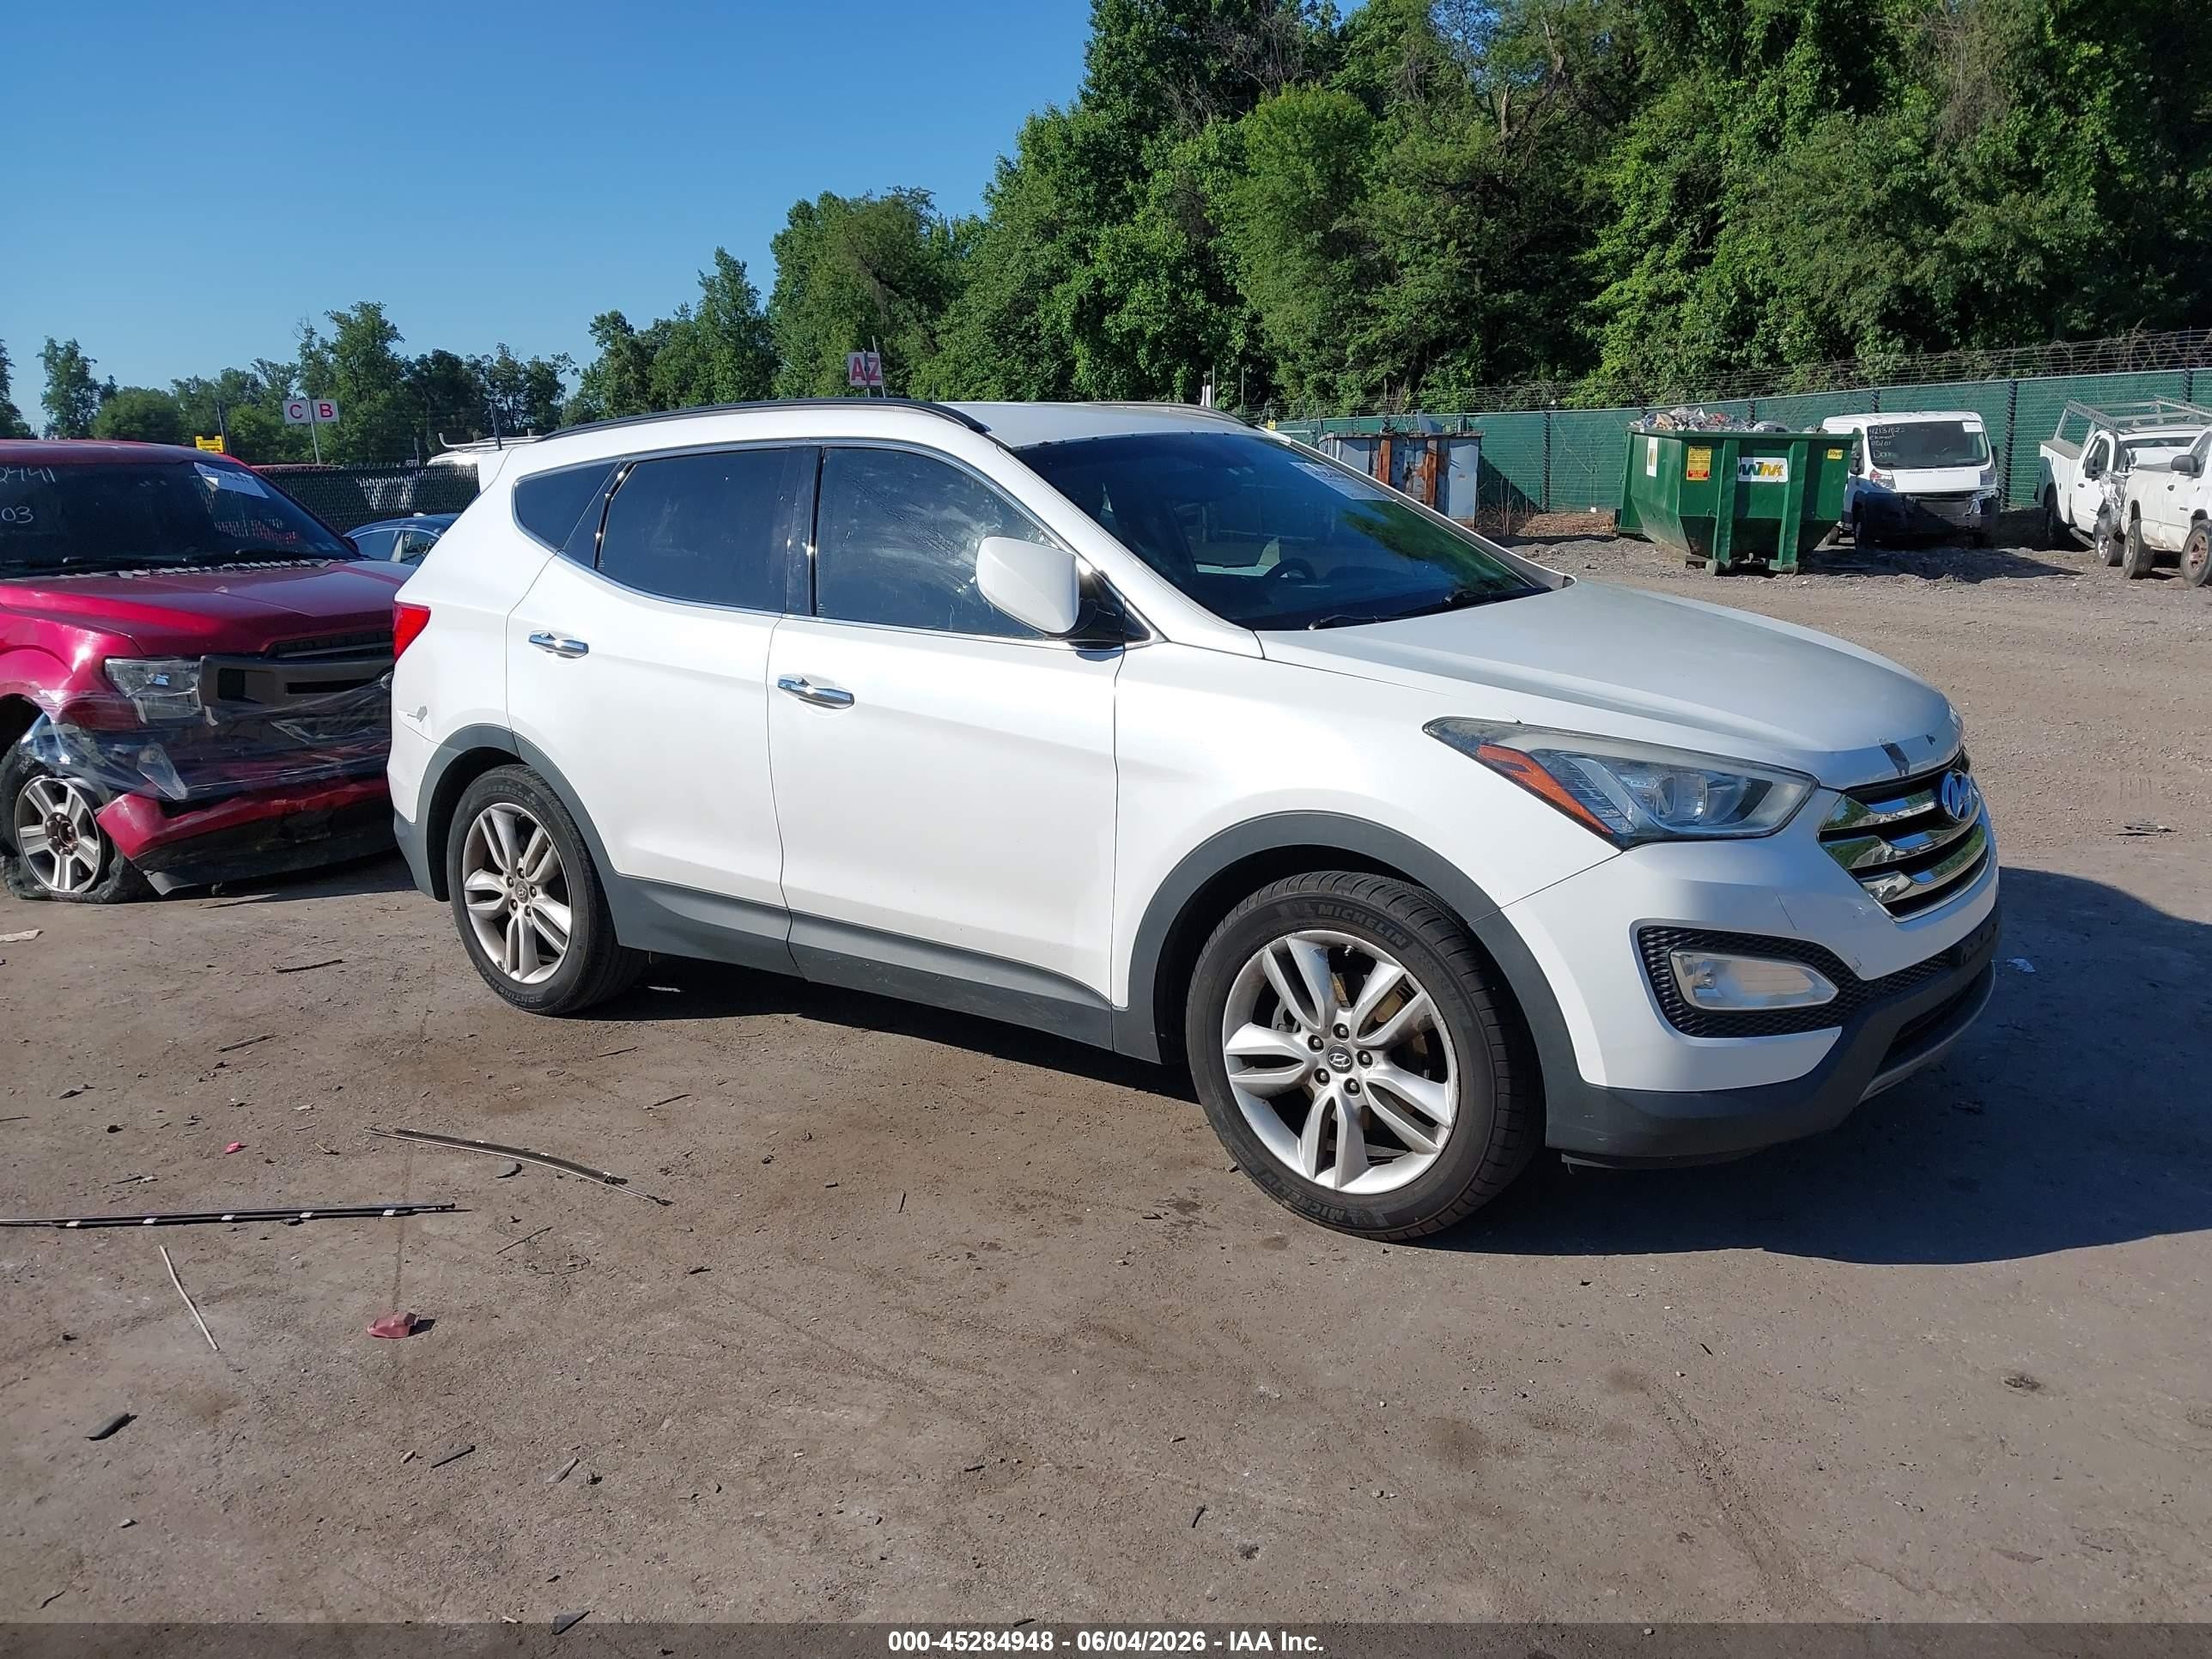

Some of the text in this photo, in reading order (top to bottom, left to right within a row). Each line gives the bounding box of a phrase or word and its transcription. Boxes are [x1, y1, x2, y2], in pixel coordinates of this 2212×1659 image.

[289, 403, 333, 419] C B
[1317, 904, 1409, 948] MICHELIN
